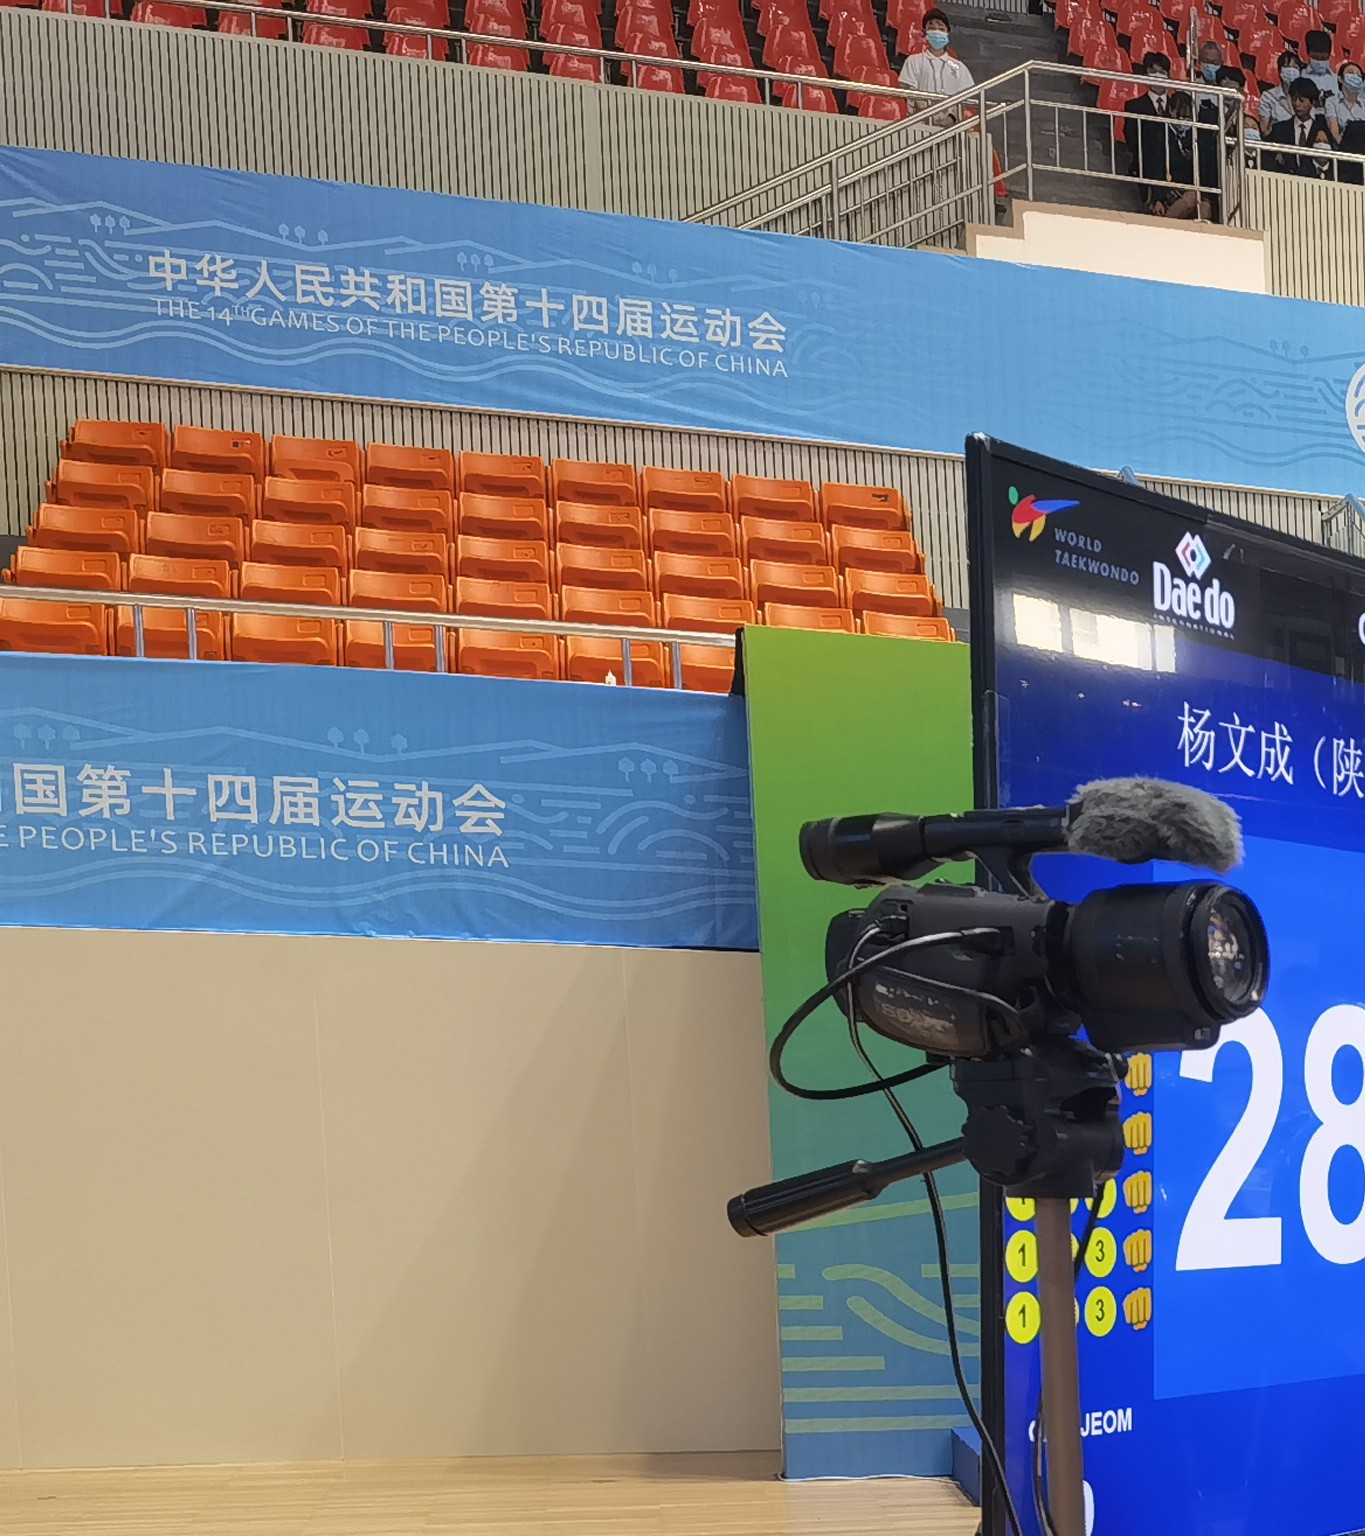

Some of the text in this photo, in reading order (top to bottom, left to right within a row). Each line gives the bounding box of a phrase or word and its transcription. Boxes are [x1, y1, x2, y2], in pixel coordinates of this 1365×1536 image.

[149, 249, 788, 353] 中华人民共和国第十四届运动会
[152, 298, 200, 319] THE
[346, 317, 380, 336] OF
[382, 320, 433, 342] THE
[438, 325, 551, 354] PEOPLE'S
[558, 337, 673, 366] REPUBLIC
[679, 350, 709, 369] OF
[716, 354, 788, 378] CHINA
[1054, 528, 1102, 553] WORLD
[1055, 549, 1140, 585] TAEKWONDO
[13, 763, 506, 836] 国第十四届运动会
[19, 825, 178, 855] PEOPLE'S
[189, 832, 349, 862] REPUBLIC
[357, 839, 400, 862] OF
[407, 841, 509, 868] CHINA
[1018, 1239, 1105, 1267] 1 3
[1018, 1299, 1105, 1328] 1 3
